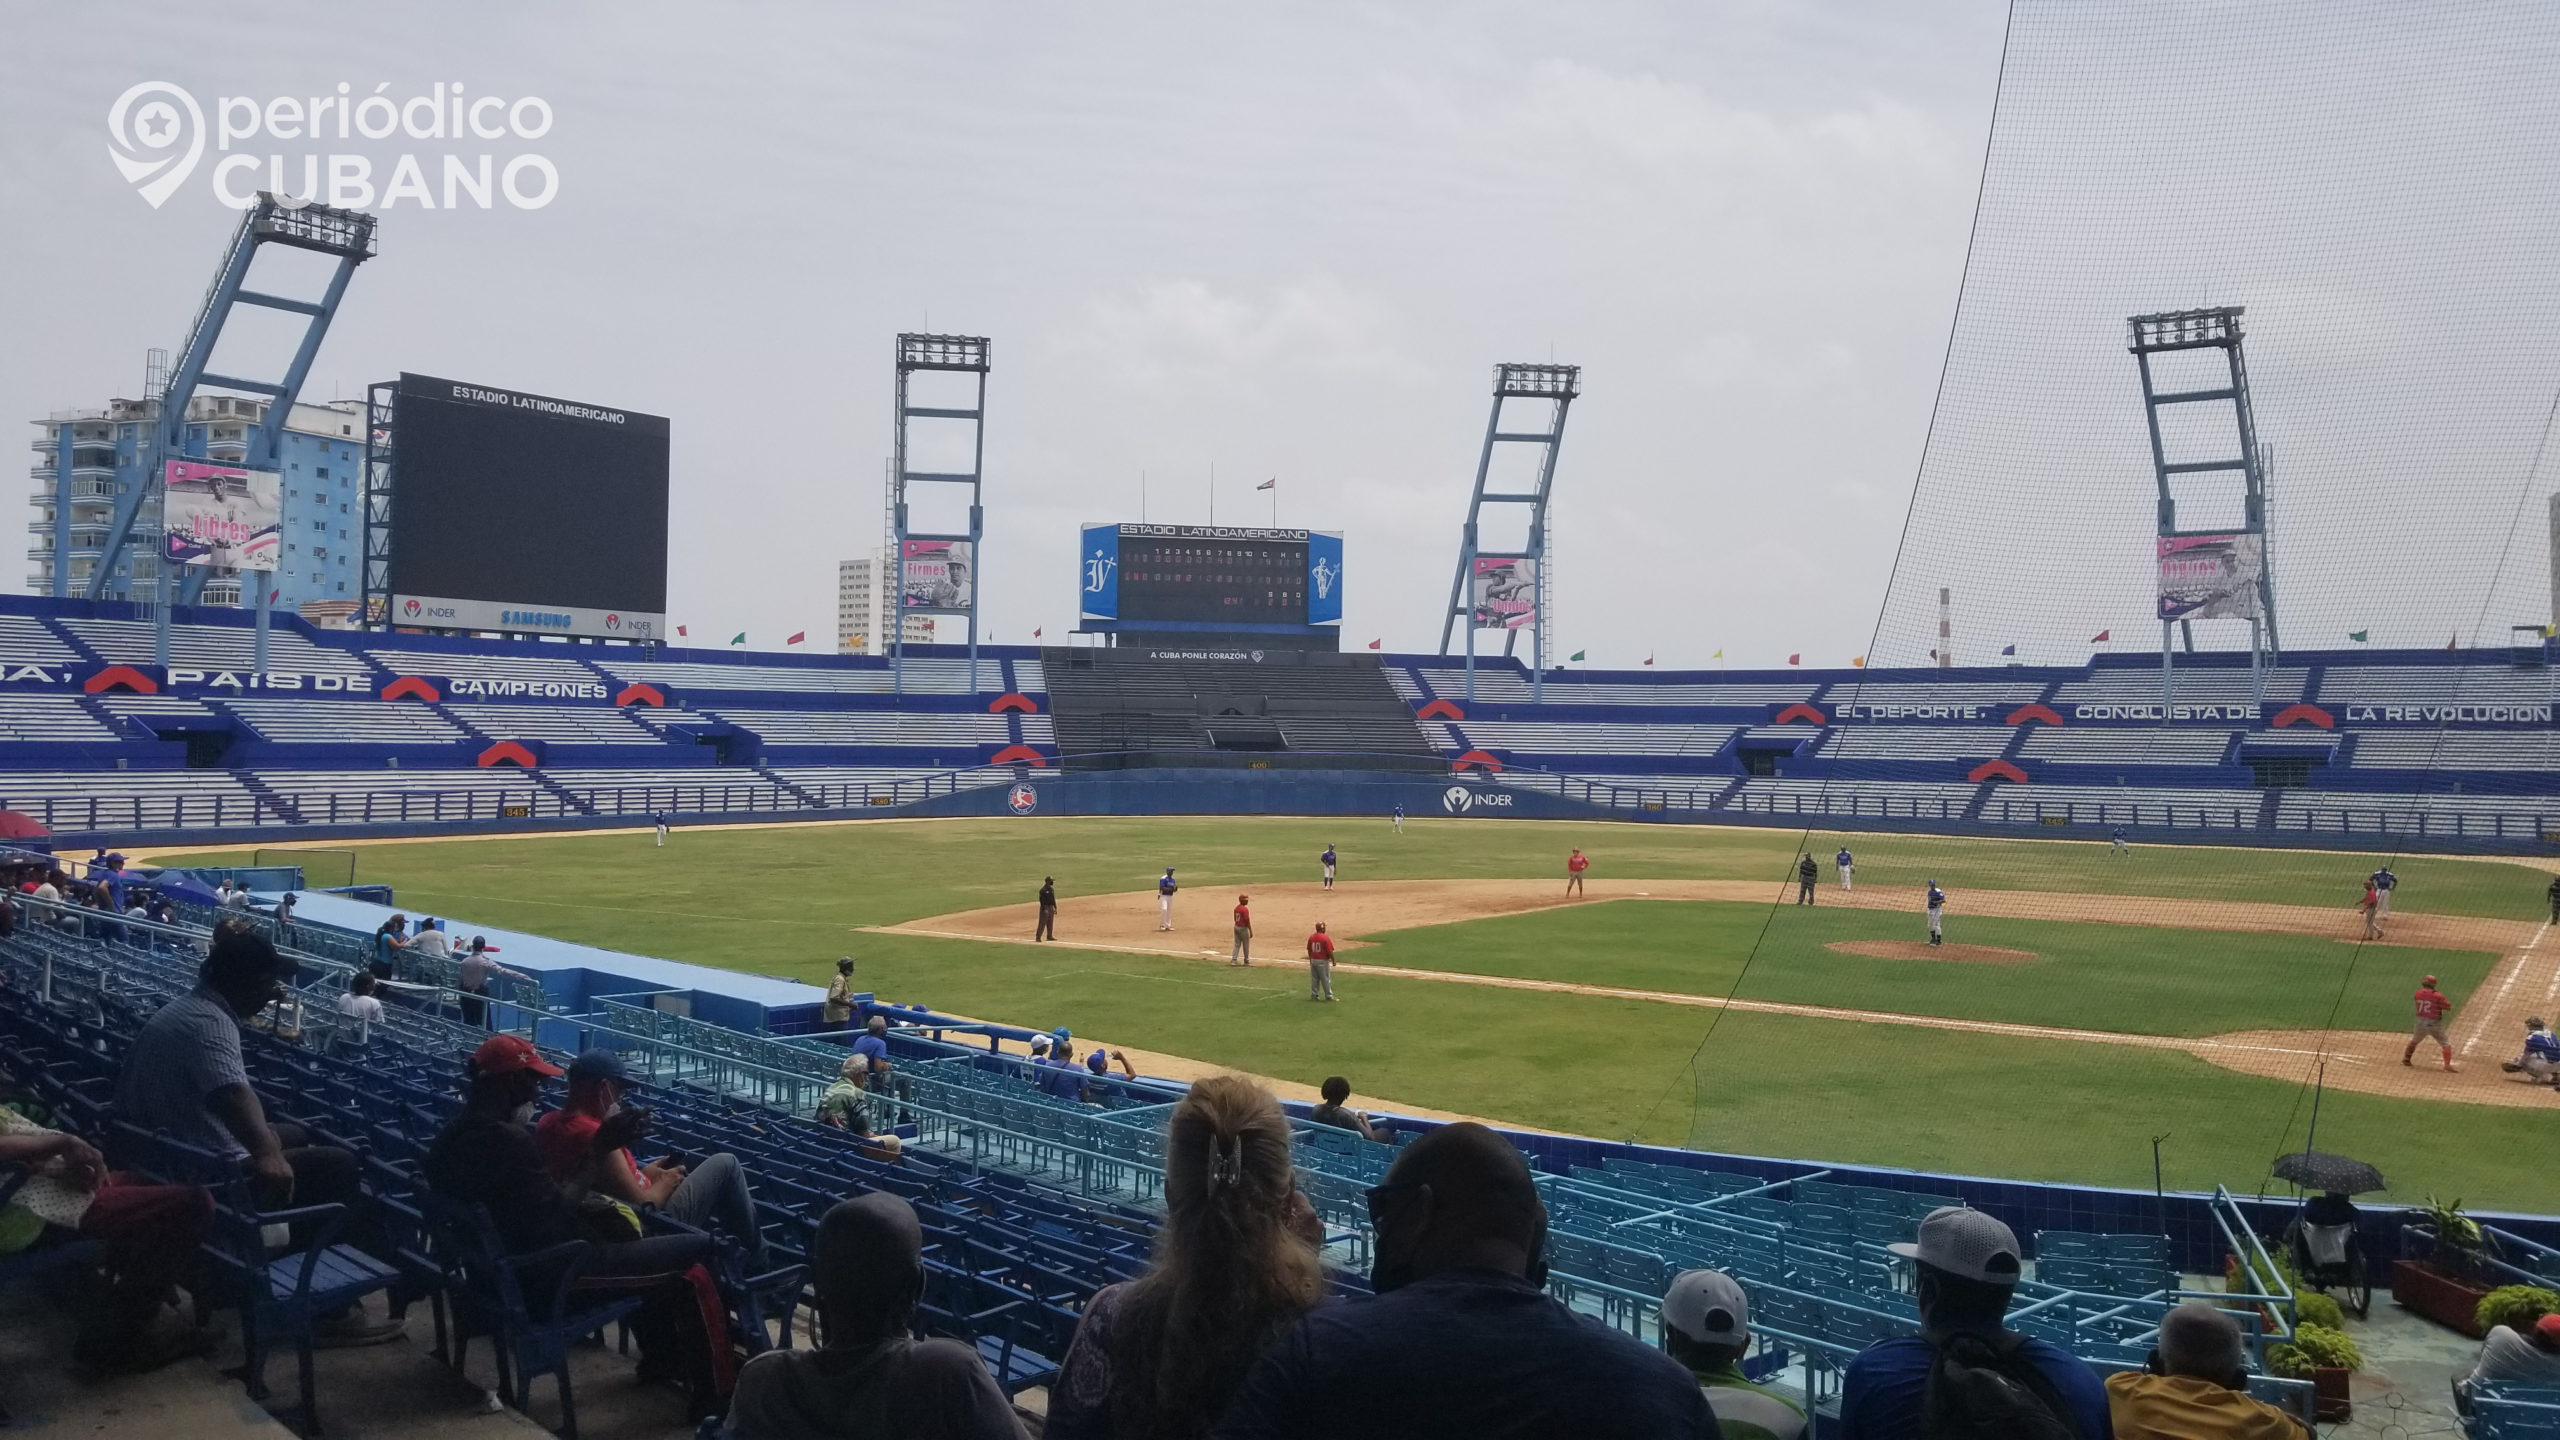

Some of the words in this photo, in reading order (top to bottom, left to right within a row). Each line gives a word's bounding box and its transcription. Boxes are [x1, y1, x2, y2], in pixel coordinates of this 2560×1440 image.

[453, 386, 508, 404] ESTADIO
[513, 396, 625, 424] LATINOAMERICANO
[193, 514, 250, 541] Libres
[1120, 524, 1175, 535] ESTADIO
[1181, 527, 1307, 539] LATINOAMERICANO
[907, 562, 946, 576] Firmes
[427, 607, 456, 619] INDER
[1493, 599, 1533, 613] Unidos
[501, 610, 572, 628] SAMSUNG
[628, 620, 652, 631] INDER
[1209, 651, 1247, 660] CORAZÓN
[315, 674, 372, 692] DE
[450, 680, 607, 698] CAMPEONES
[1835, 704, 1863, 718] EL
[2075, 705, 2220, 719] CONQUISTA
[2226, 705, 2261, 719] DE
[2346, 706, 2377, 720] LA
[2385, 705, 2552, 721] REVOLUCION
[1475, 794, 1512, 806] INDER
[506, 808, 524, 816] 345
[2418, 1000, 2432, 1013] 72
